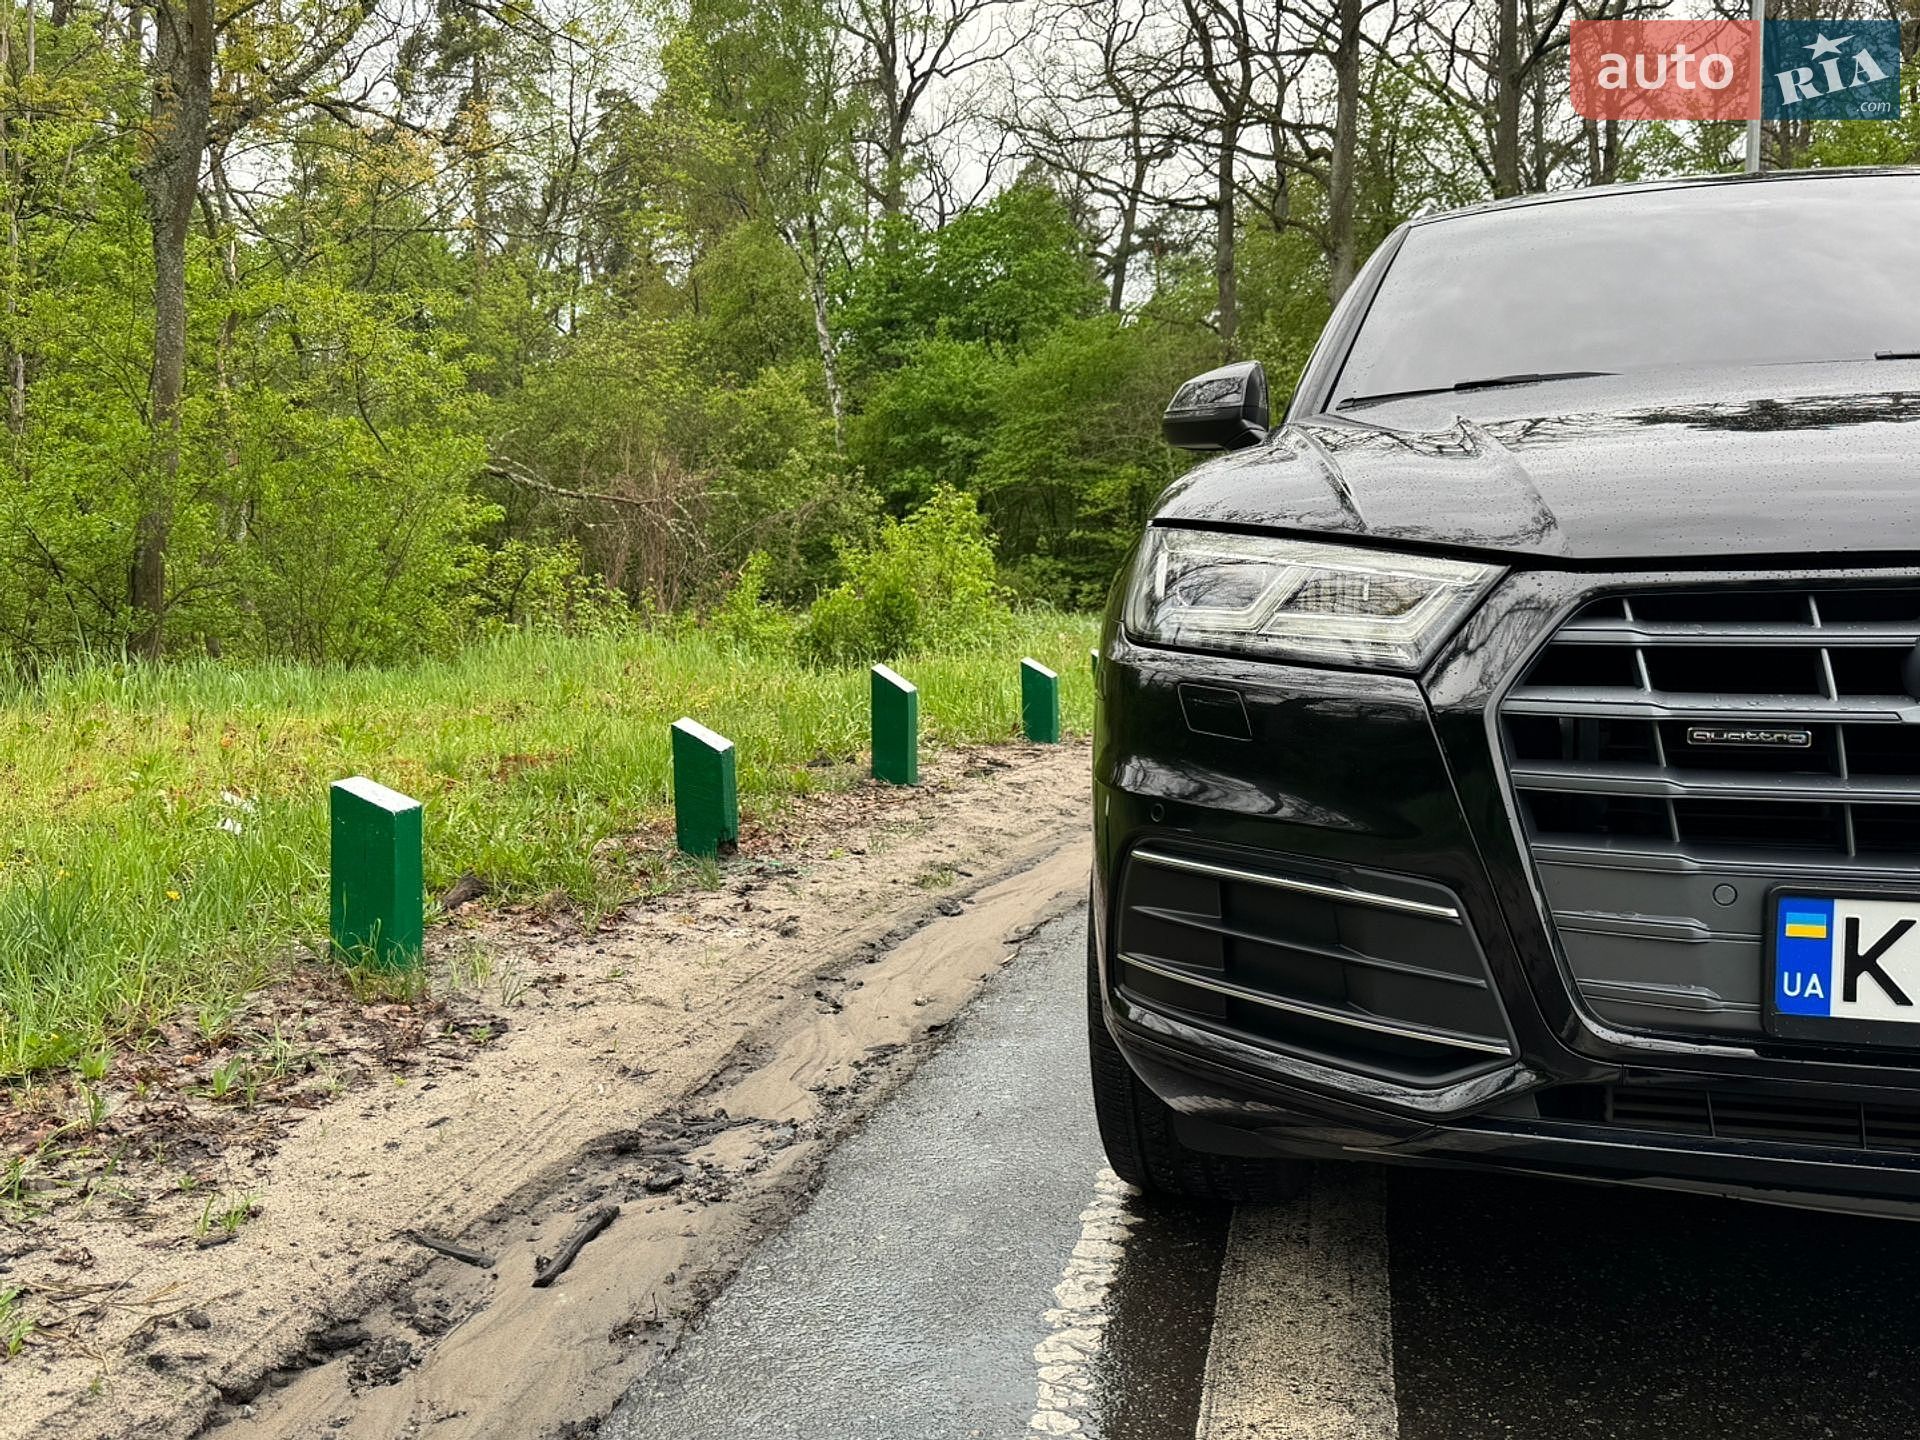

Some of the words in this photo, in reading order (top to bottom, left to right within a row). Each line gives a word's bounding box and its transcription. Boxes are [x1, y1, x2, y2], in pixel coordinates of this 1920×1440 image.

[1693, 730, 1807, 744] quattro
[1842, 917, 1917, 1007] K
[1783, 971, 1825, 999] UA
